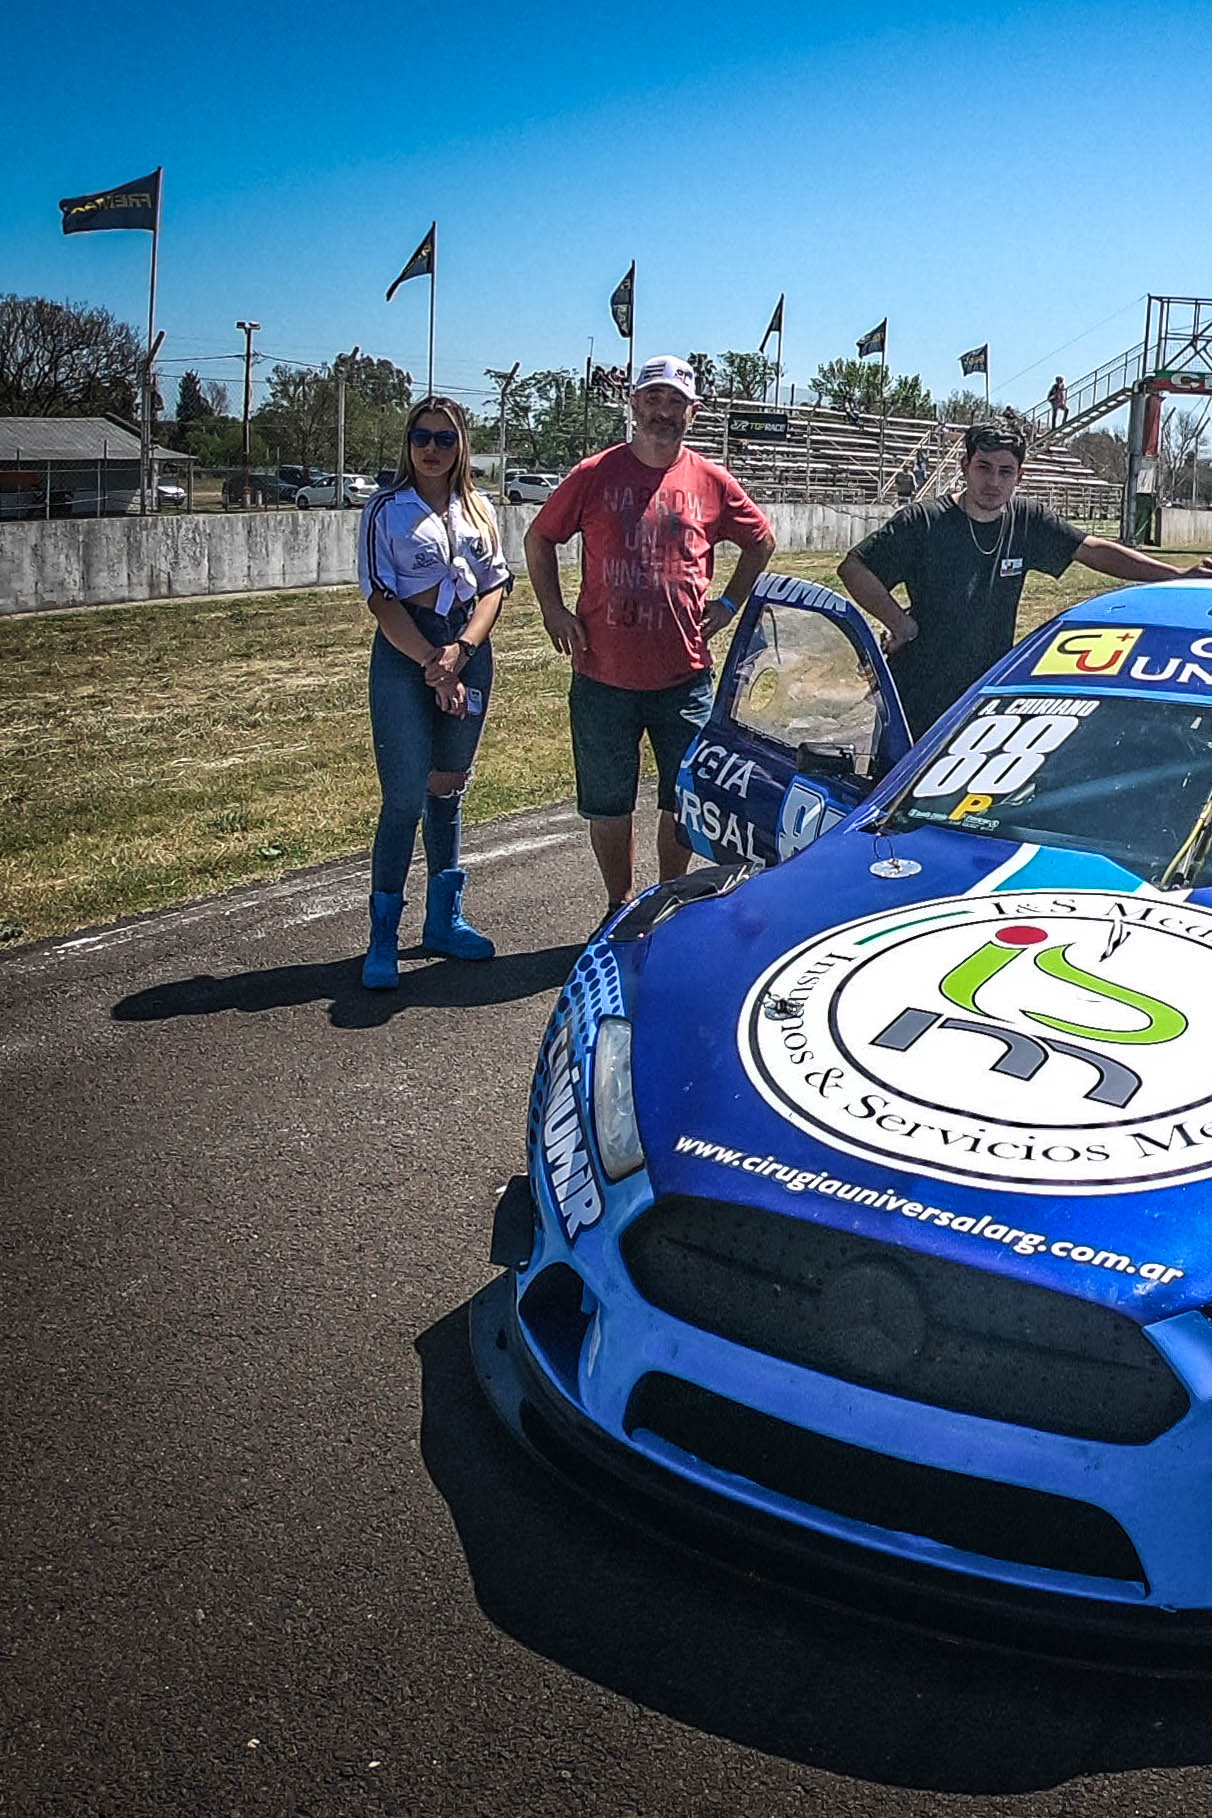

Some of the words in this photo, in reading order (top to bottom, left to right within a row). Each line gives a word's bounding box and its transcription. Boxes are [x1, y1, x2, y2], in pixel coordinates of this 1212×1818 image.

[1004, 699, 1100, 717] CHIRIANO
[912, 714, 1079, 798] 88
[842, 1093, 1111, 1163] Servicios
[674, 1135, 1186, 1285] www.cirugiauniversalarg.com.ar
